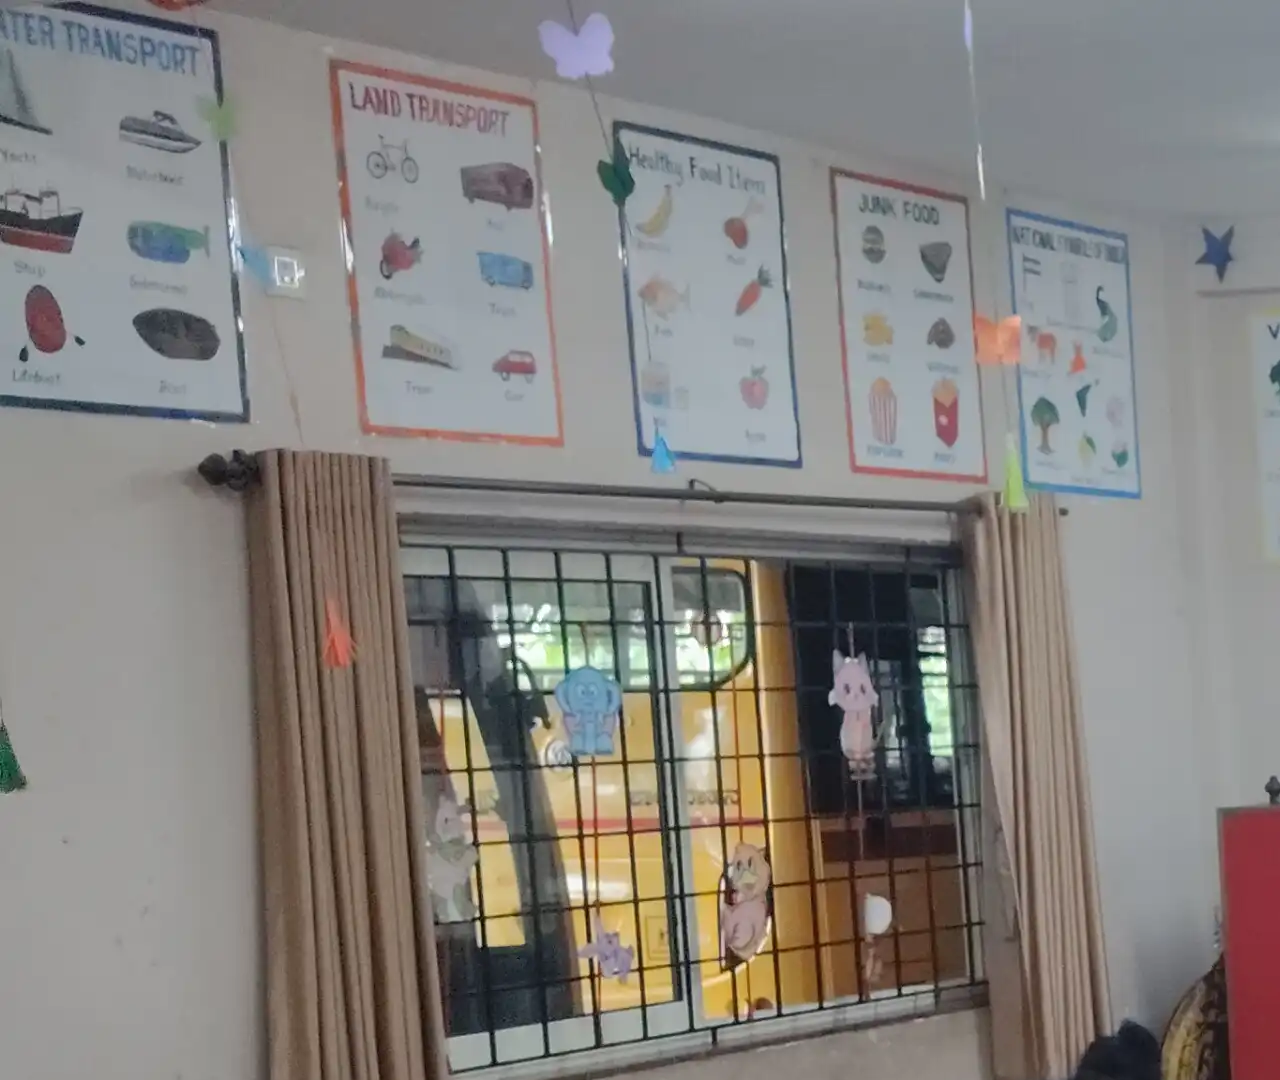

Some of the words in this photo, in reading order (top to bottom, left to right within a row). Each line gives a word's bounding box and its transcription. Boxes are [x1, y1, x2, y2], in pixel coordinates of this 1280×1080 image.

[61, 20, 200, 77] TRANSPORT
[349, 82, 402, 117] LAND
[405, 92, 510, 137] TRANSPORT
[628, 145, 685, 187] Healthy
[689, 156, 722, 185] Food
[859, 194, 897, 220] JUNK
[903, 201, 940, 225] FOOD
